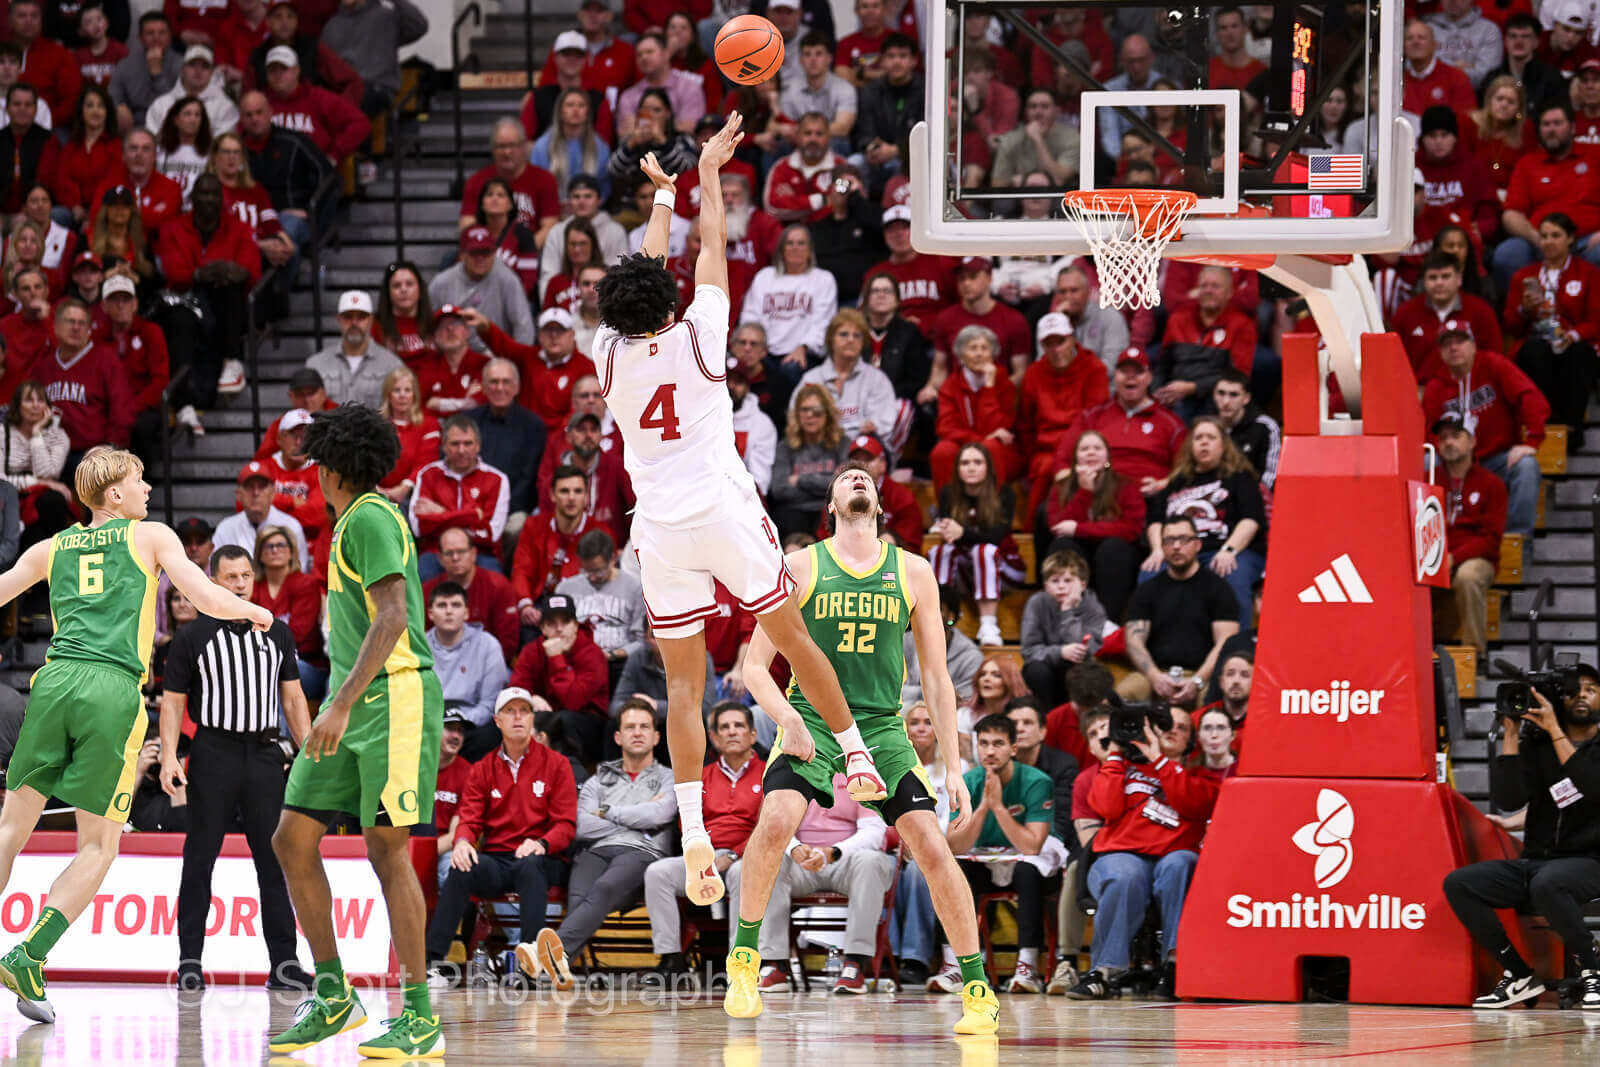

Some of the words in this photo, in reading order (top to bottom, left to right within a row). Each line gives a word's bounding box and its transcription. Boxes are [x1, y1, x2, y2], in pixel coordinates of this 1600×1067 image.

[639, 383, 682, 442] 4
[79, 552, 105, 596] 6
[815, 591, 901, 624] OREGON
[837, 622, 877, 654] 32
[1280, 680, 1385, 722] meijer
[90, 893, 375, 940] TOMORW
[1226, 892, 1426, 930] Smithville
